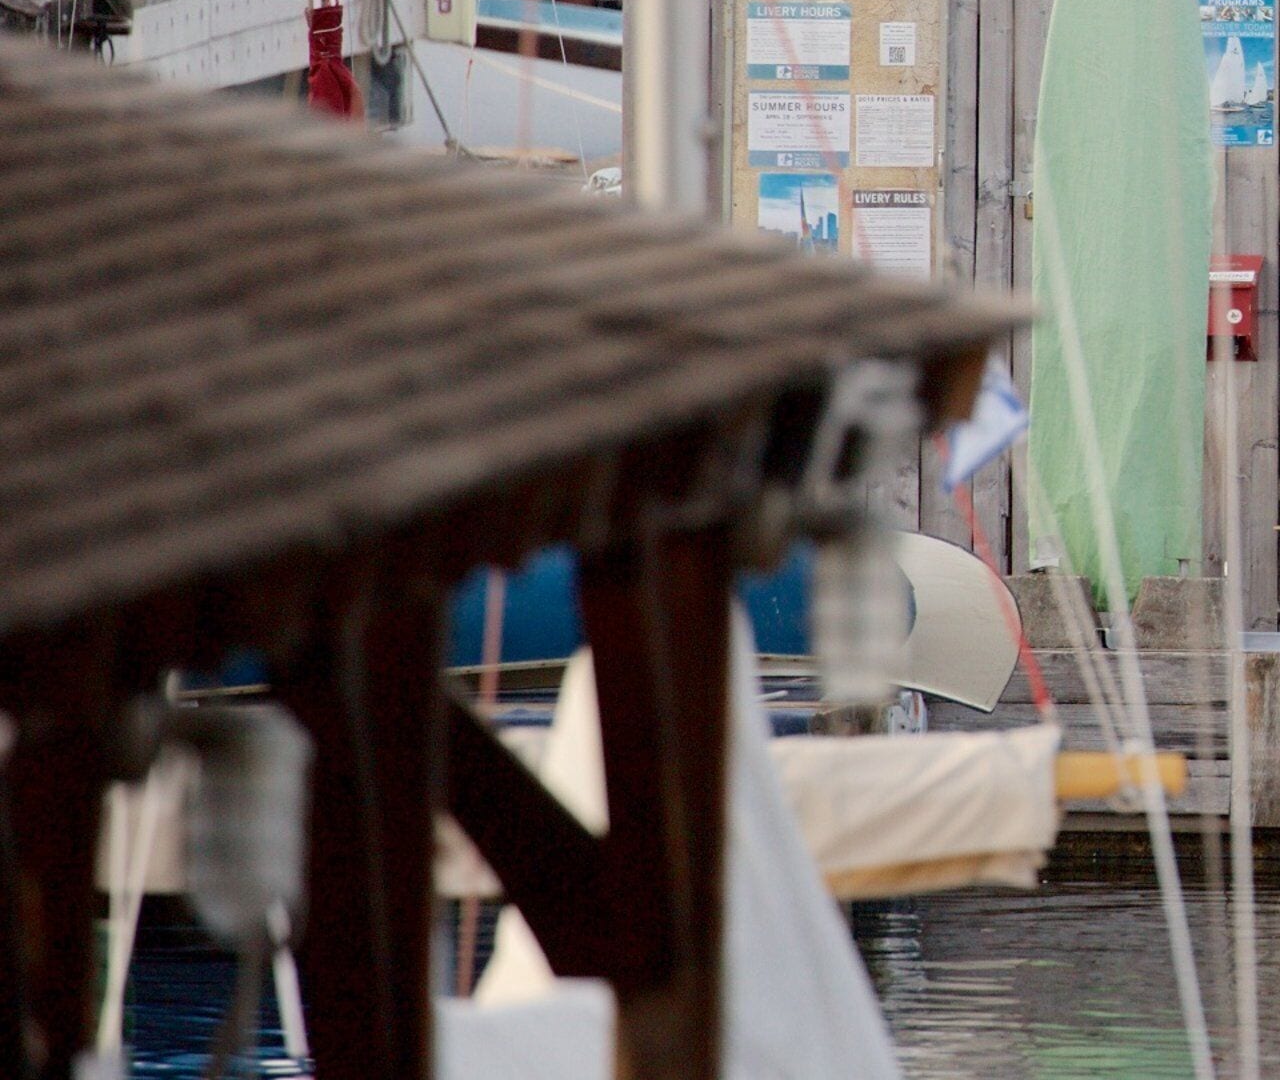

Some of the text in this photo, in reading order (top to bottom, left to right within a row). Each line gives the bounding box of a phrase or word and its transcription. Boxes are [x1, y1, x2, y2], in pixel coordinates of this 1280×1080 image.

[756, 6, 841, 17] LIVERY HOURS
[752, 102, 846, 112] SUMMER HOURS
[855, 193, 927, 204] LIVERY RULES
